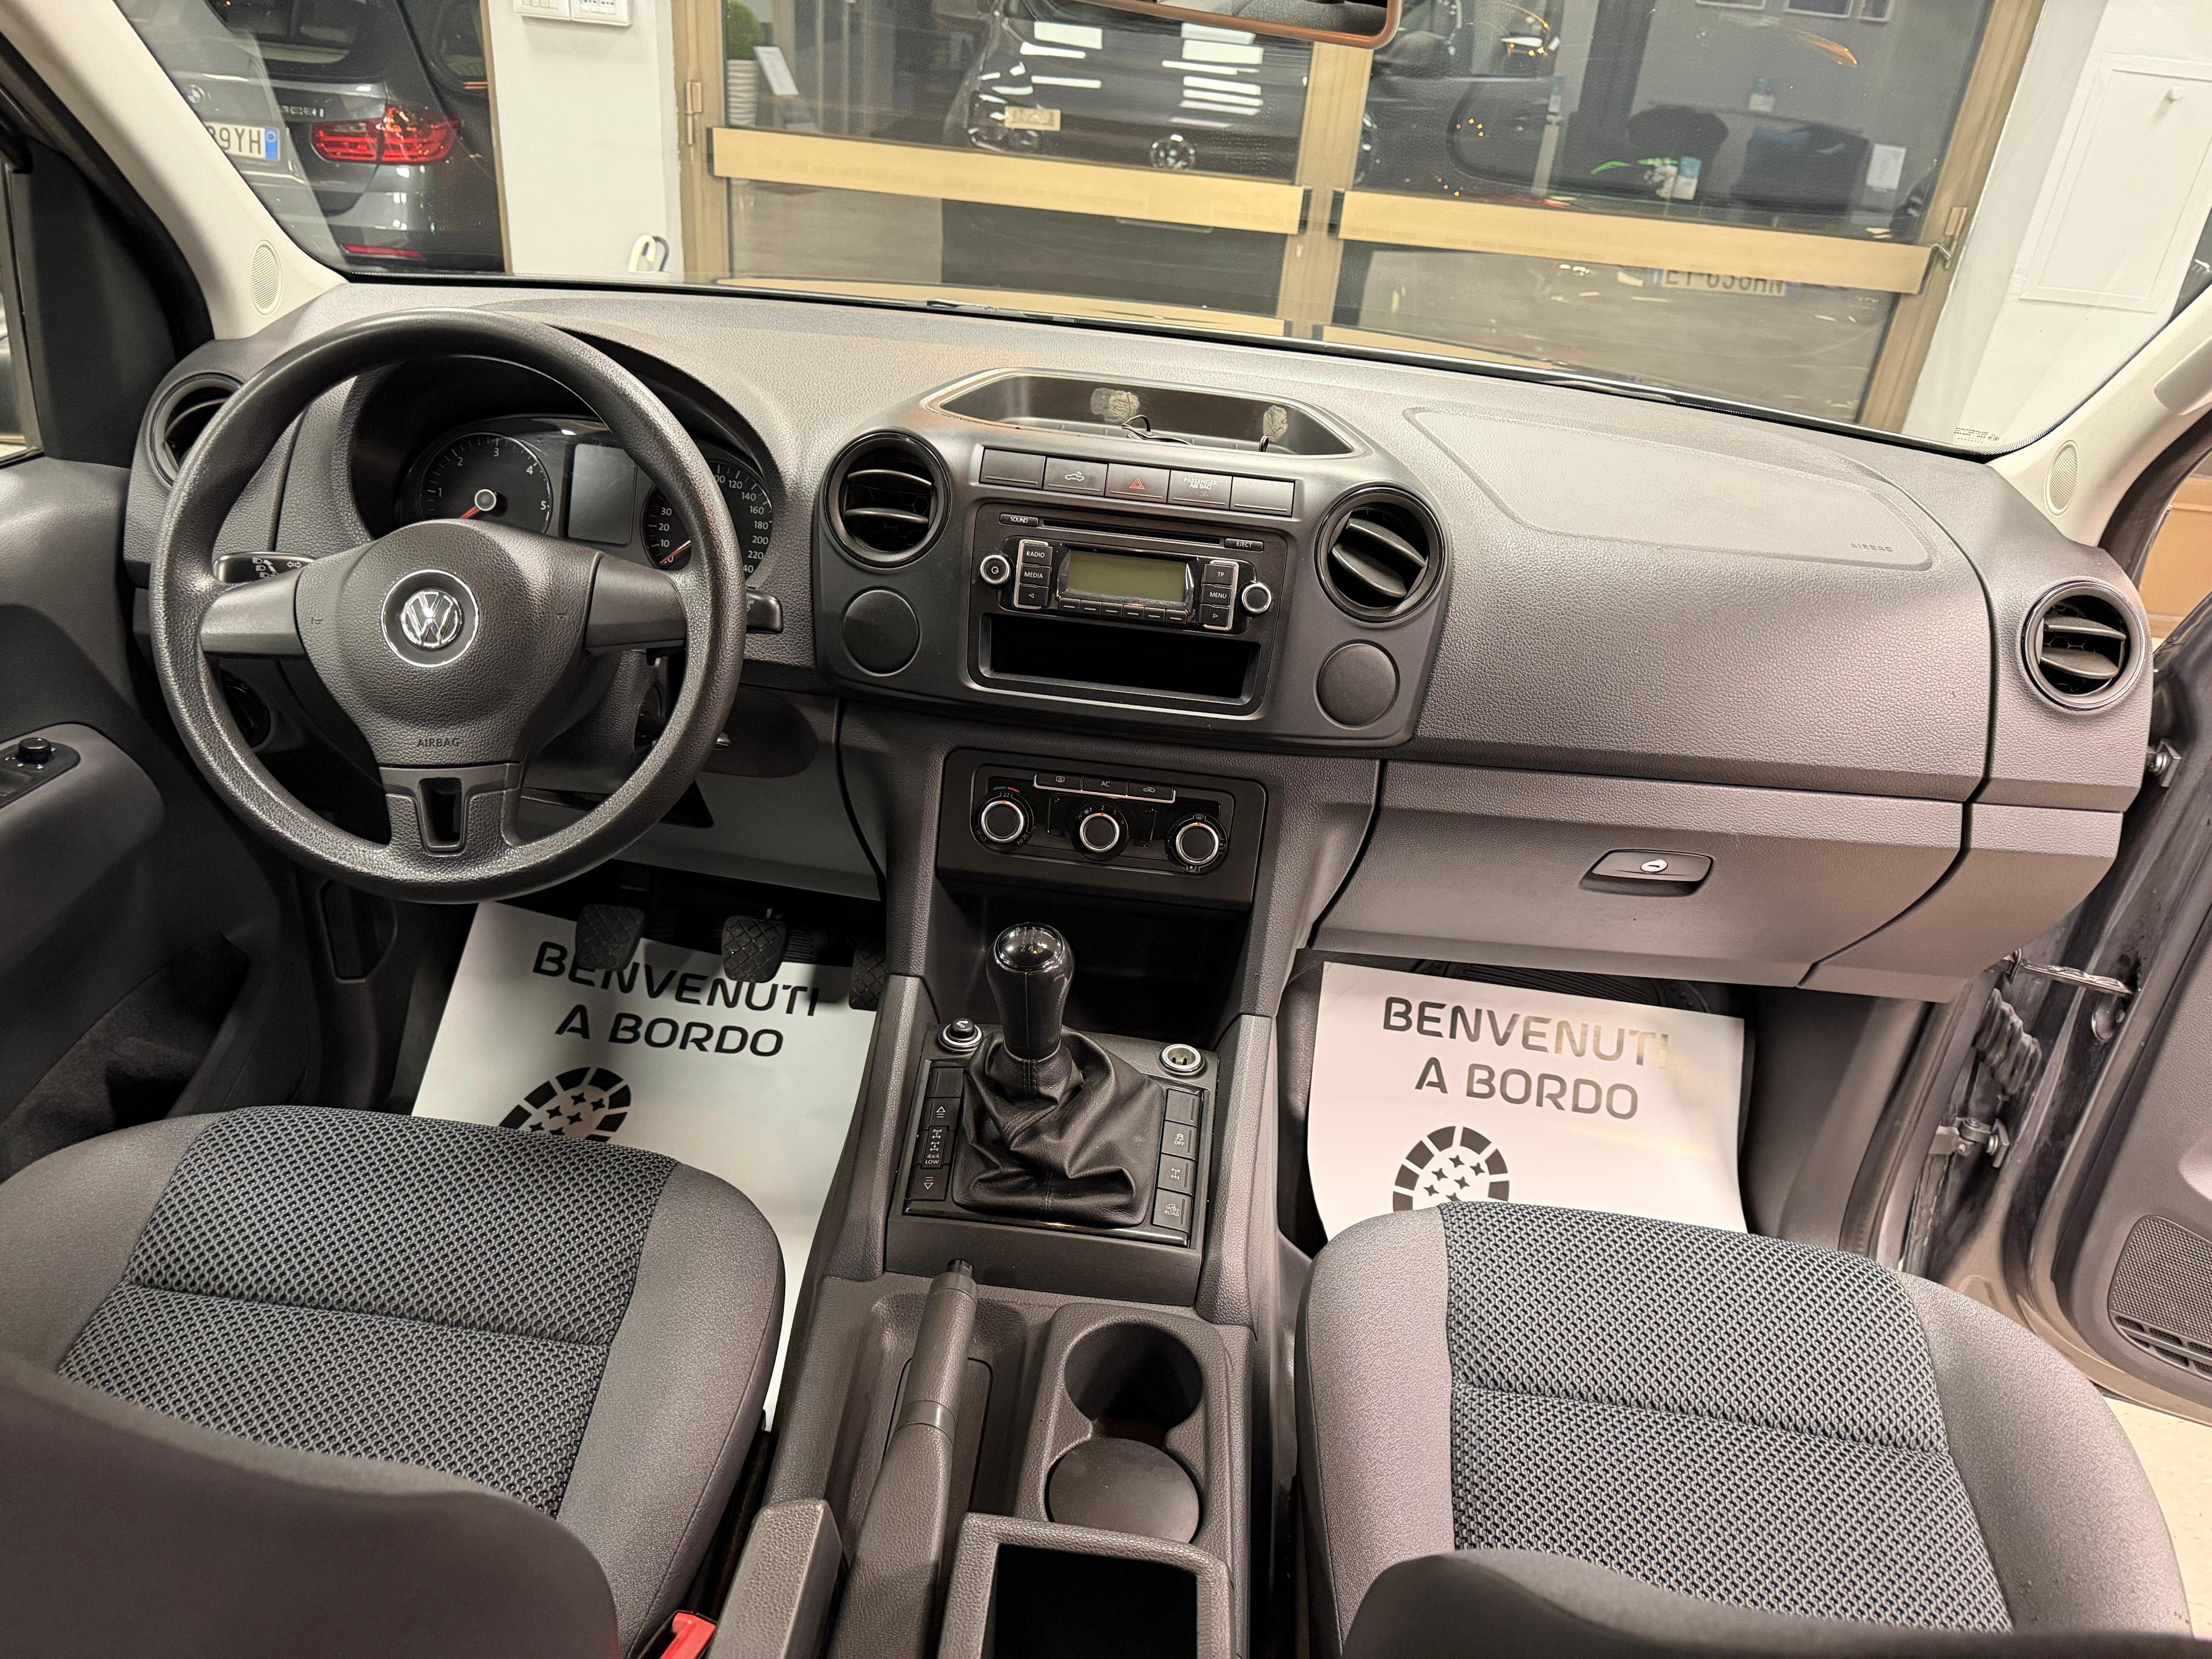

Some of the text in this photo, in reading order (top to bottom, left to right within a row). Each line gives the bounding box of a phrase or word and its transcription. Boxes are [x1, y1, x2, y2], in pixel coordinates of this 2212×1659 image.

[494, 448, 499, 457] 3
[457, 457, 463, 466] 2
[526, 465, 534, 475] 4
[714, 475, 725, 483] 00
[1184, 477, 1217, 486] PASSENGER
[728, 480, 743, 489] 120
[438, 488, 442, 497] 1
[741, 492, 756, 502] 140
[540, 501, 547, 510] 5
[661, 507, 672, 516] 30
[750, 506, 764, 515] 160
[658, 523, 670, 531] 20
[754, 521, 769, 530] 180
[661, 539, 670, 547] 10
[752, 536, 769, 545] 200
[1851, 543, 1893, 552] AIRBAG
[748, 550, 763, 559] 220
[743, 565, 753, 573] 40
[417, 737, 460, 747] AIRBAG
[533, 941, 819, 1016] BENVENUTI
[555, 1004, 784, 1057] A BORDO
[1383, 996, 1669, 1069] BENVENUTI
[1414, 1057, 1638, 1120] A BORDO
